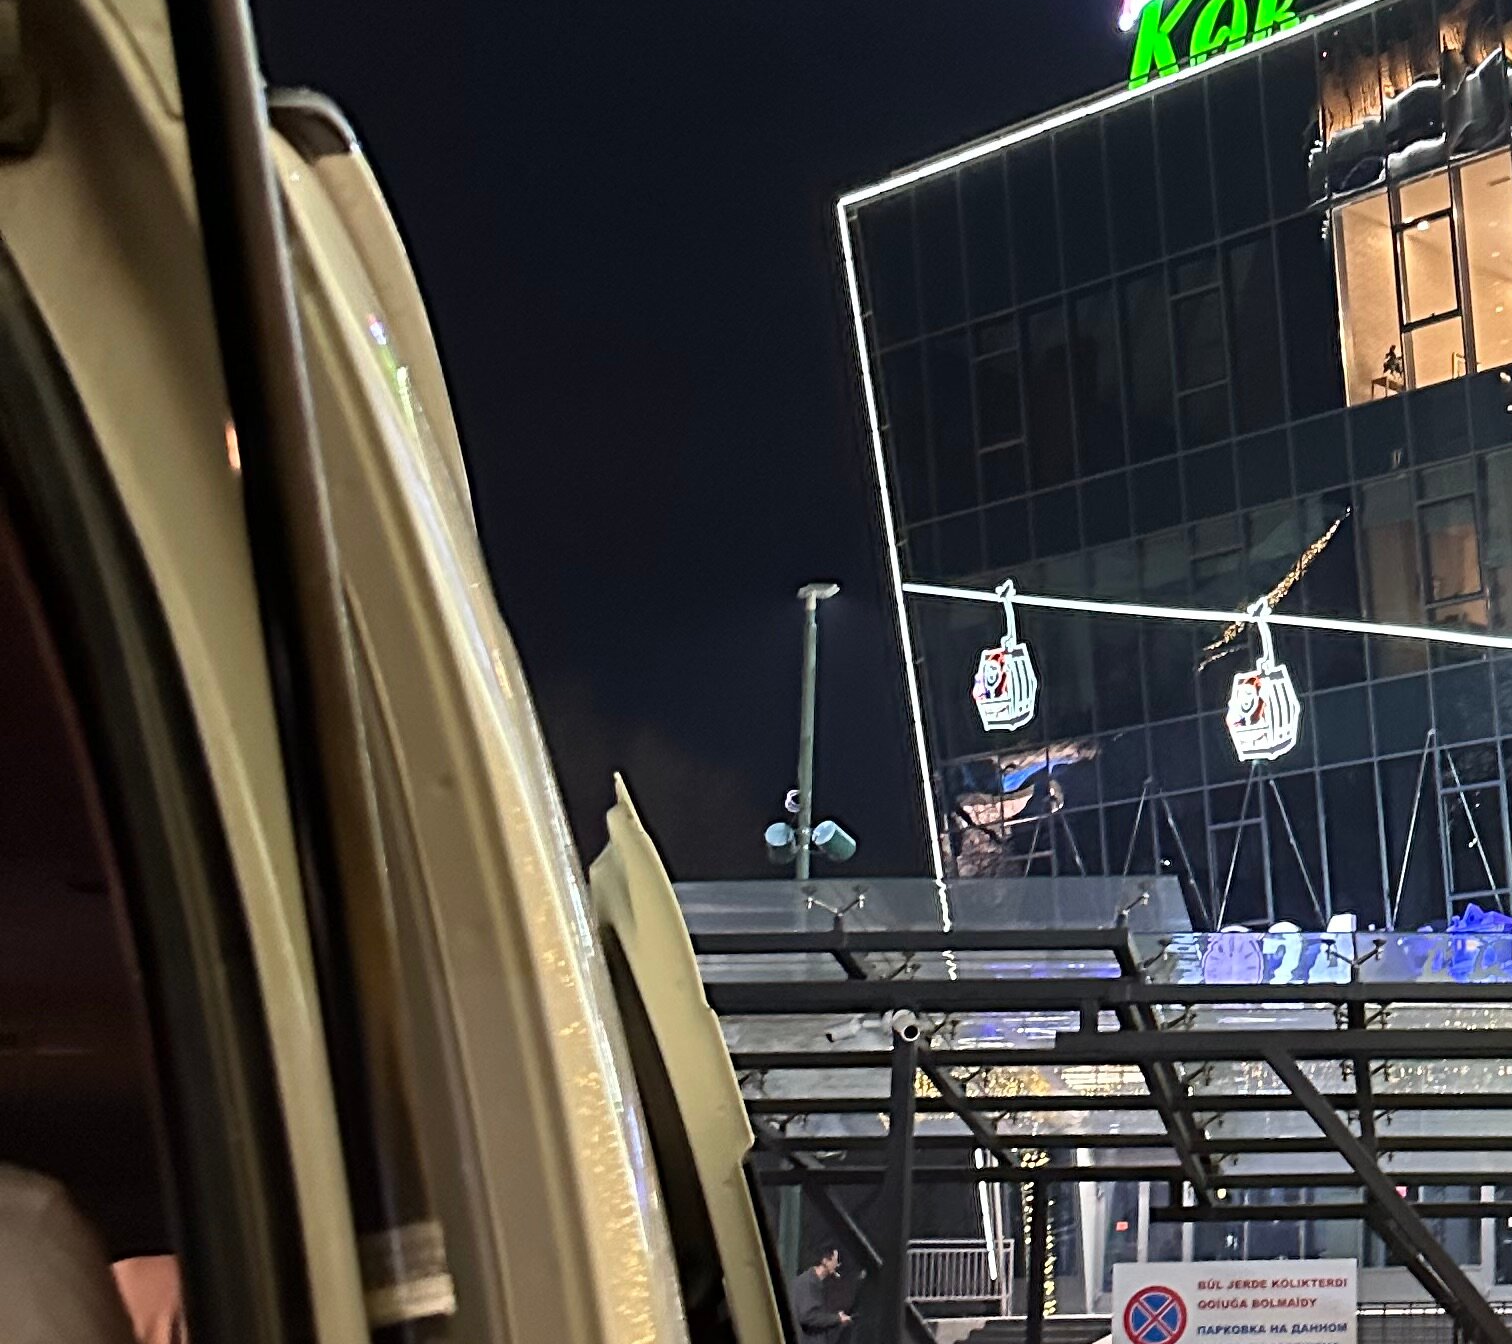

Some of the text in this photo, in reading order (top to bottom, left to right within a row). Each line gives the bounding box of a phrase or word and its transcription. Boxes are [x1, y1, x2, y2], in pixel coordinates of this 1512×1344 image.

[1197, 1322, 1348, 1335] ПАРКОВКА НА ДАННОМ
